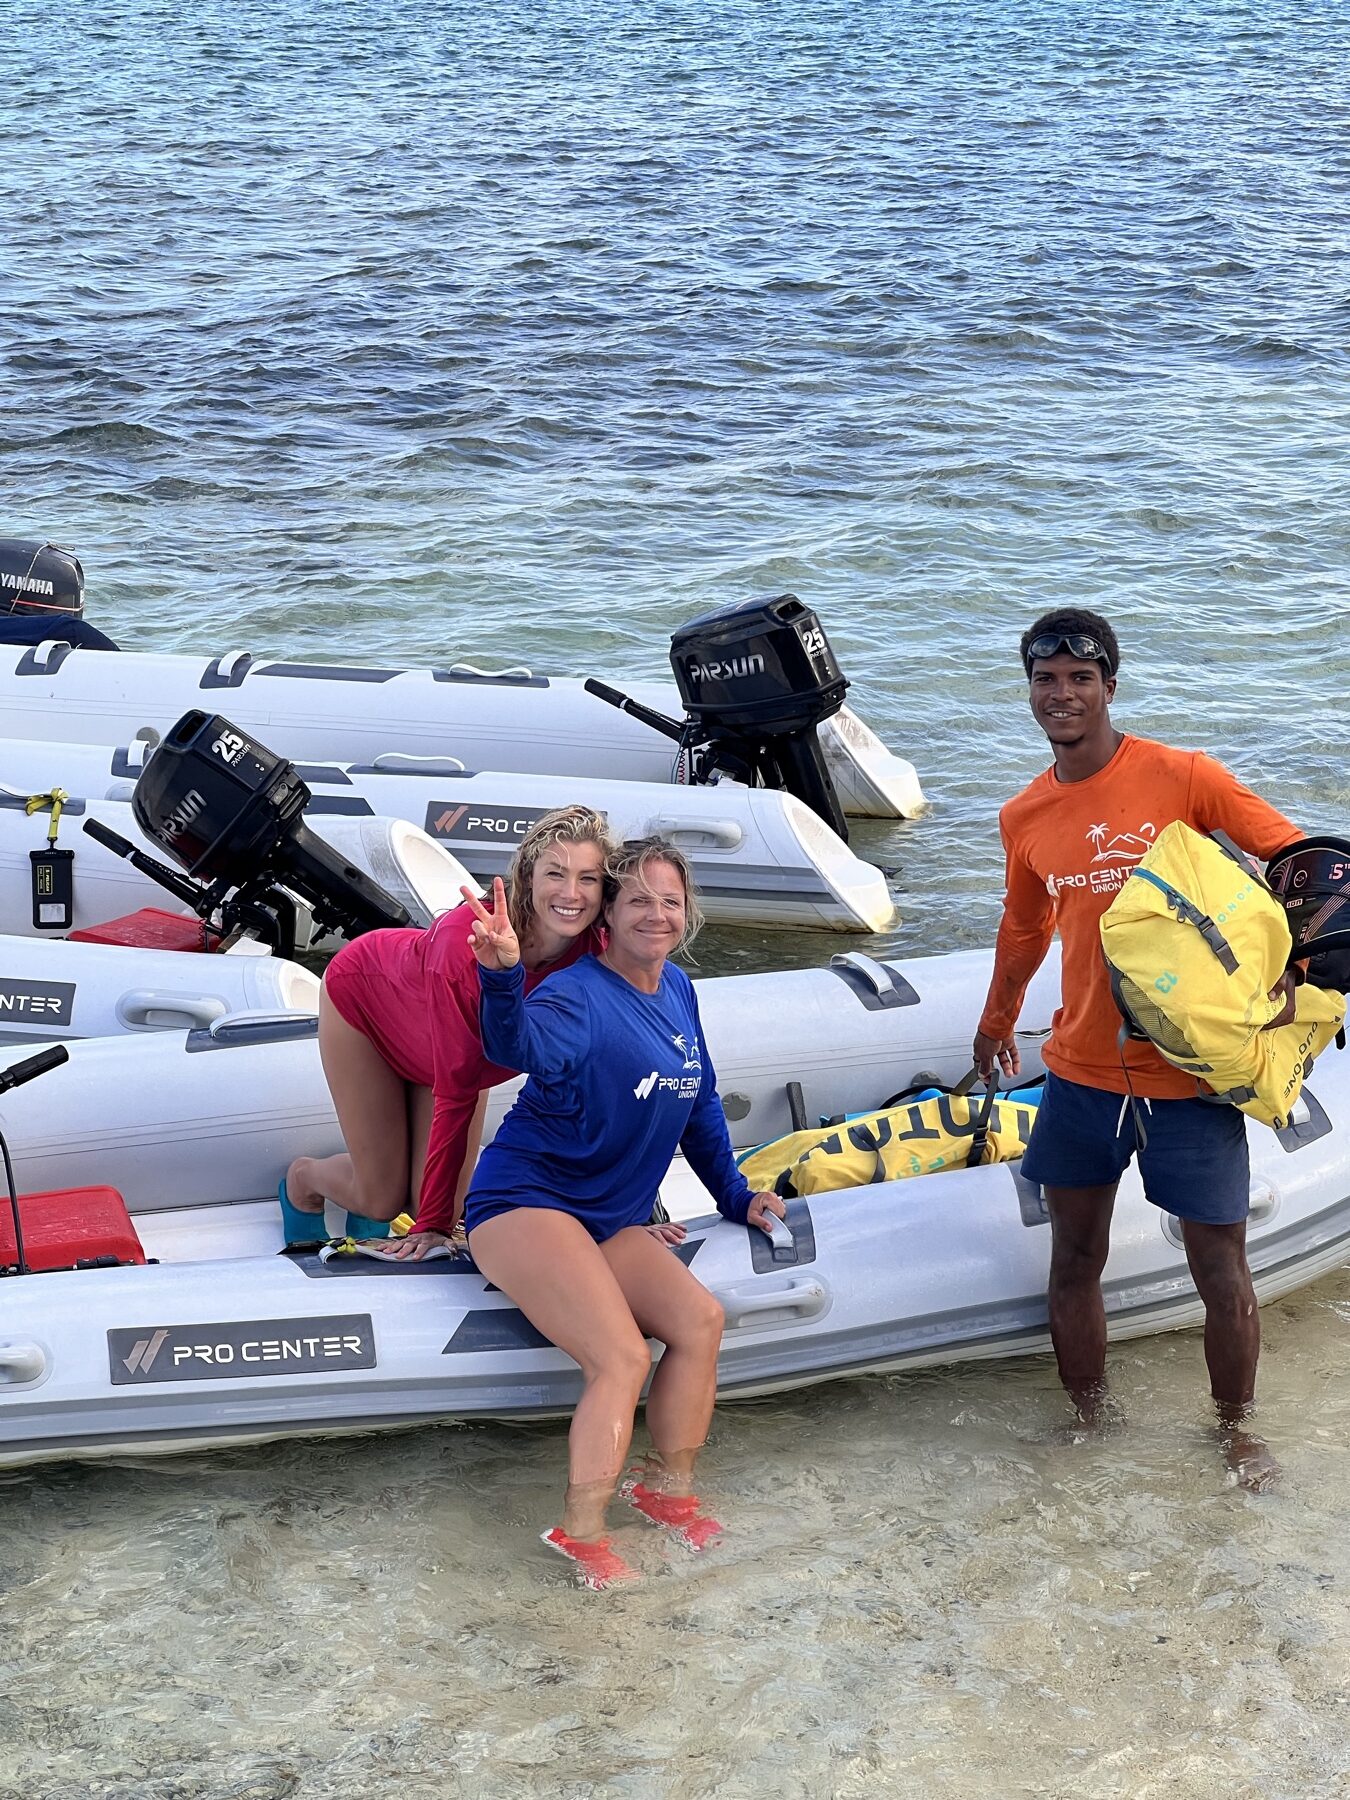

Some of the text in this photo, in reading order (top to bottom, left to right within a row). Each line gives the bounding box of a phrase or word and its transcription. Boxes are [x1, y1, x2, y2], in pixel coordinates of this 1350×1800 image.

[1, 572, 53, 596] YAMAHA
[803, 627, 825, 653] 25
[690, 654, 765, 683] PARSUN
[211, 729, 244, 763] 25
[467, 817, 509, 833] PRO
[1055, 864, 1141, 891] PRO CENT
[1091, 881, 1121, 894] UNION
[1155, 971, 1177, 993] 13
[658, 1077, 680, 1091] PRO
[678, 1090, 695, 1099] UNION
[173, 1335, 363, 1366] PRO CENTER
